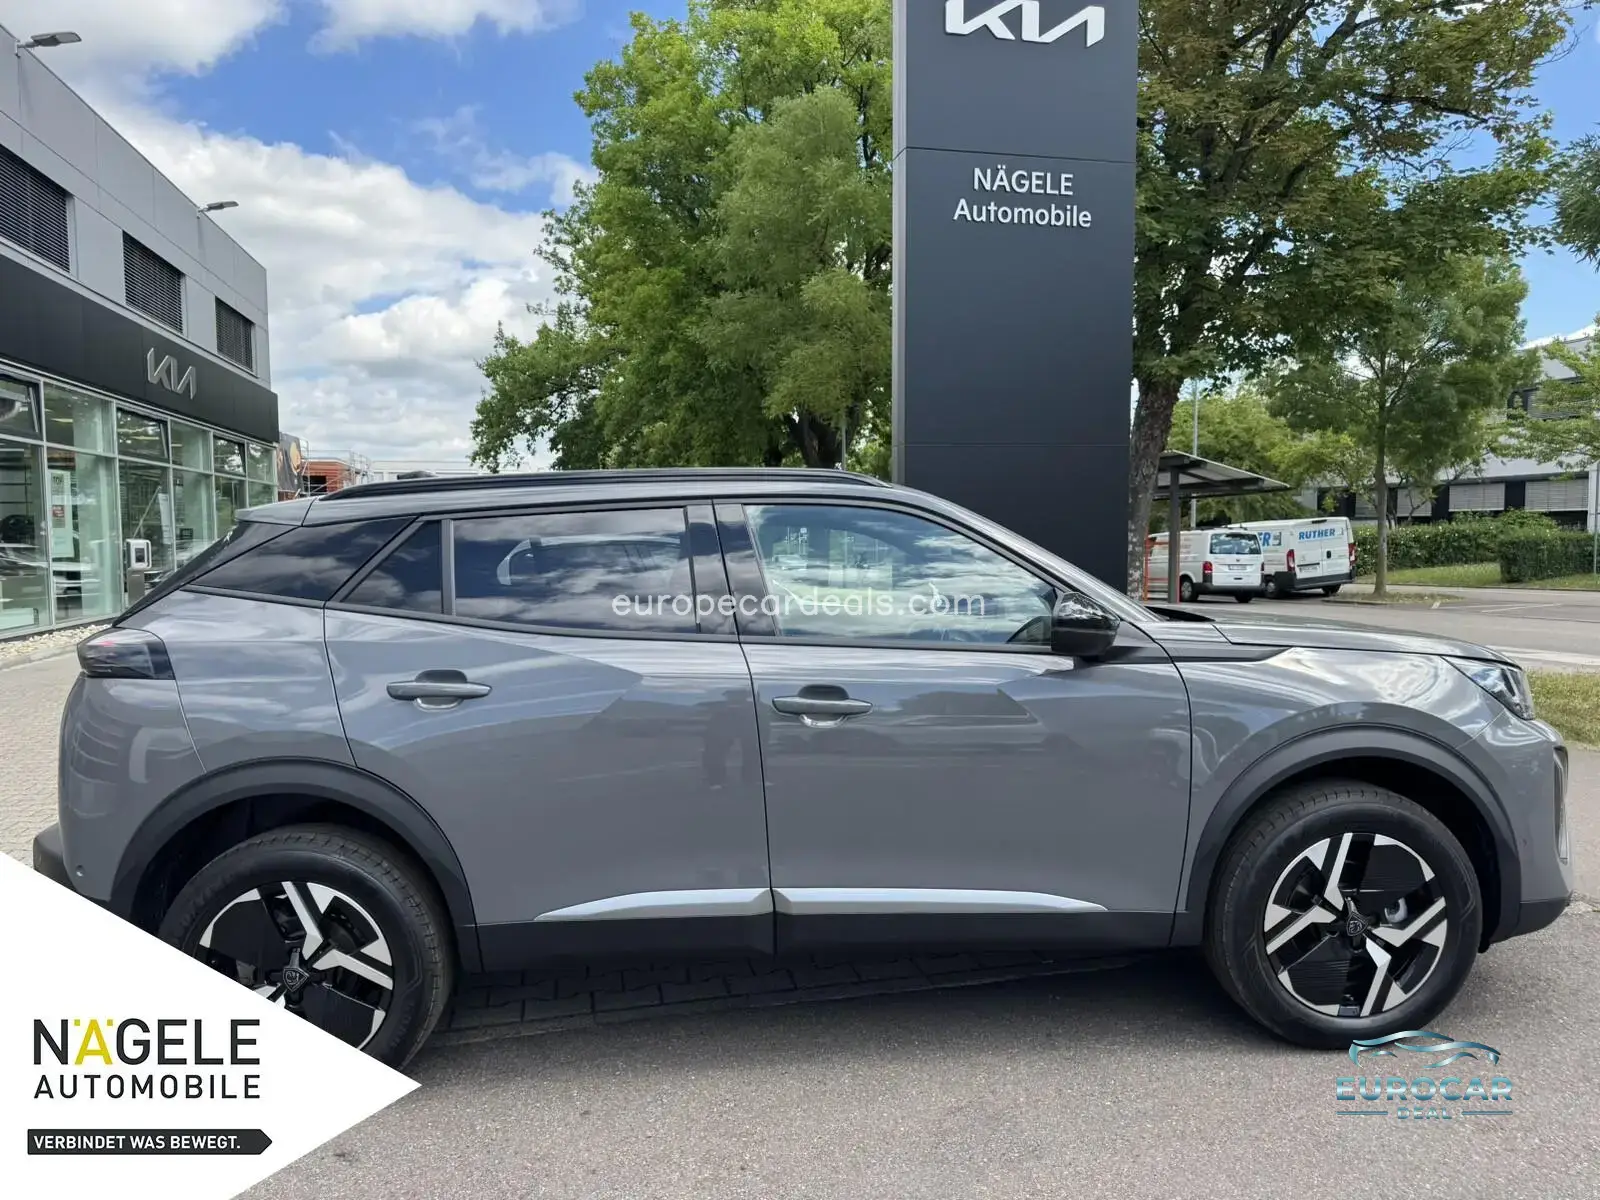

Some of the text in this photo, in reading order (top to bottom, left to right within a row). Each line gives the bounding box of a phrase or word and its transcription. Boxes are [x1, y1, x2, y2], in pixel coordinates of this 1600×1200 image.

[945, 0, 1105, 47] KIA
[973, 164, 1074, 196] NÄGELE
[953, 198, 1092, 228] Automobile
[147, 347, 197, 400] KIA
[1298, 528, 1336, 540] RUTHER
